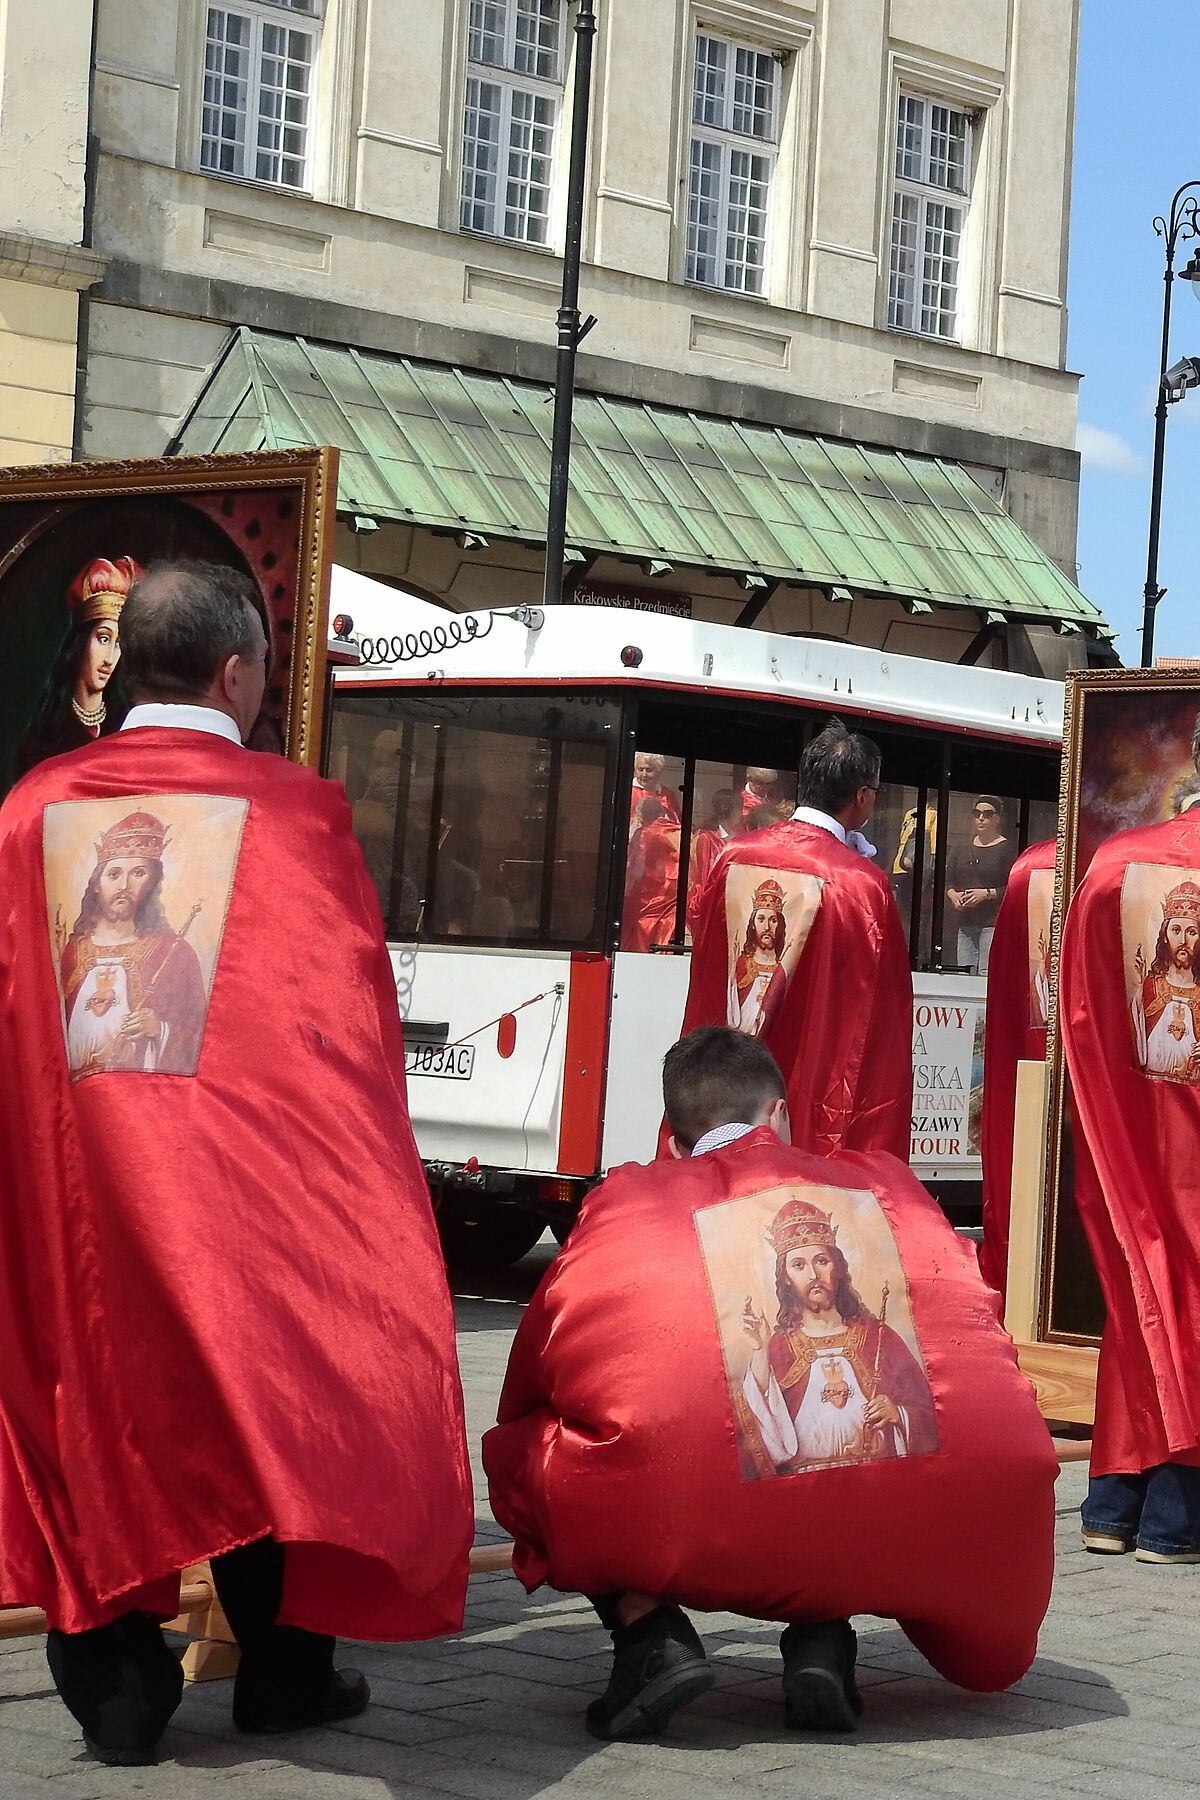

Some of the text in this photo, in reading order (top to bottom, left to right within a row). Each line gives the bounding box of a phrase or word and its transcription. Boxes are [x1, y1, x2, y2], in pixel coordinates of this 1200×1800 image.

[573, 590, 691, 617] Krakowskie Przedmieście
[913, 1005, 969, 1029] OWY
[413, 1044, 469, 1075] 103AC
[913, 1093, 966, 1111] TRAIN
[910, 1137, 961, 1155] TOUR
